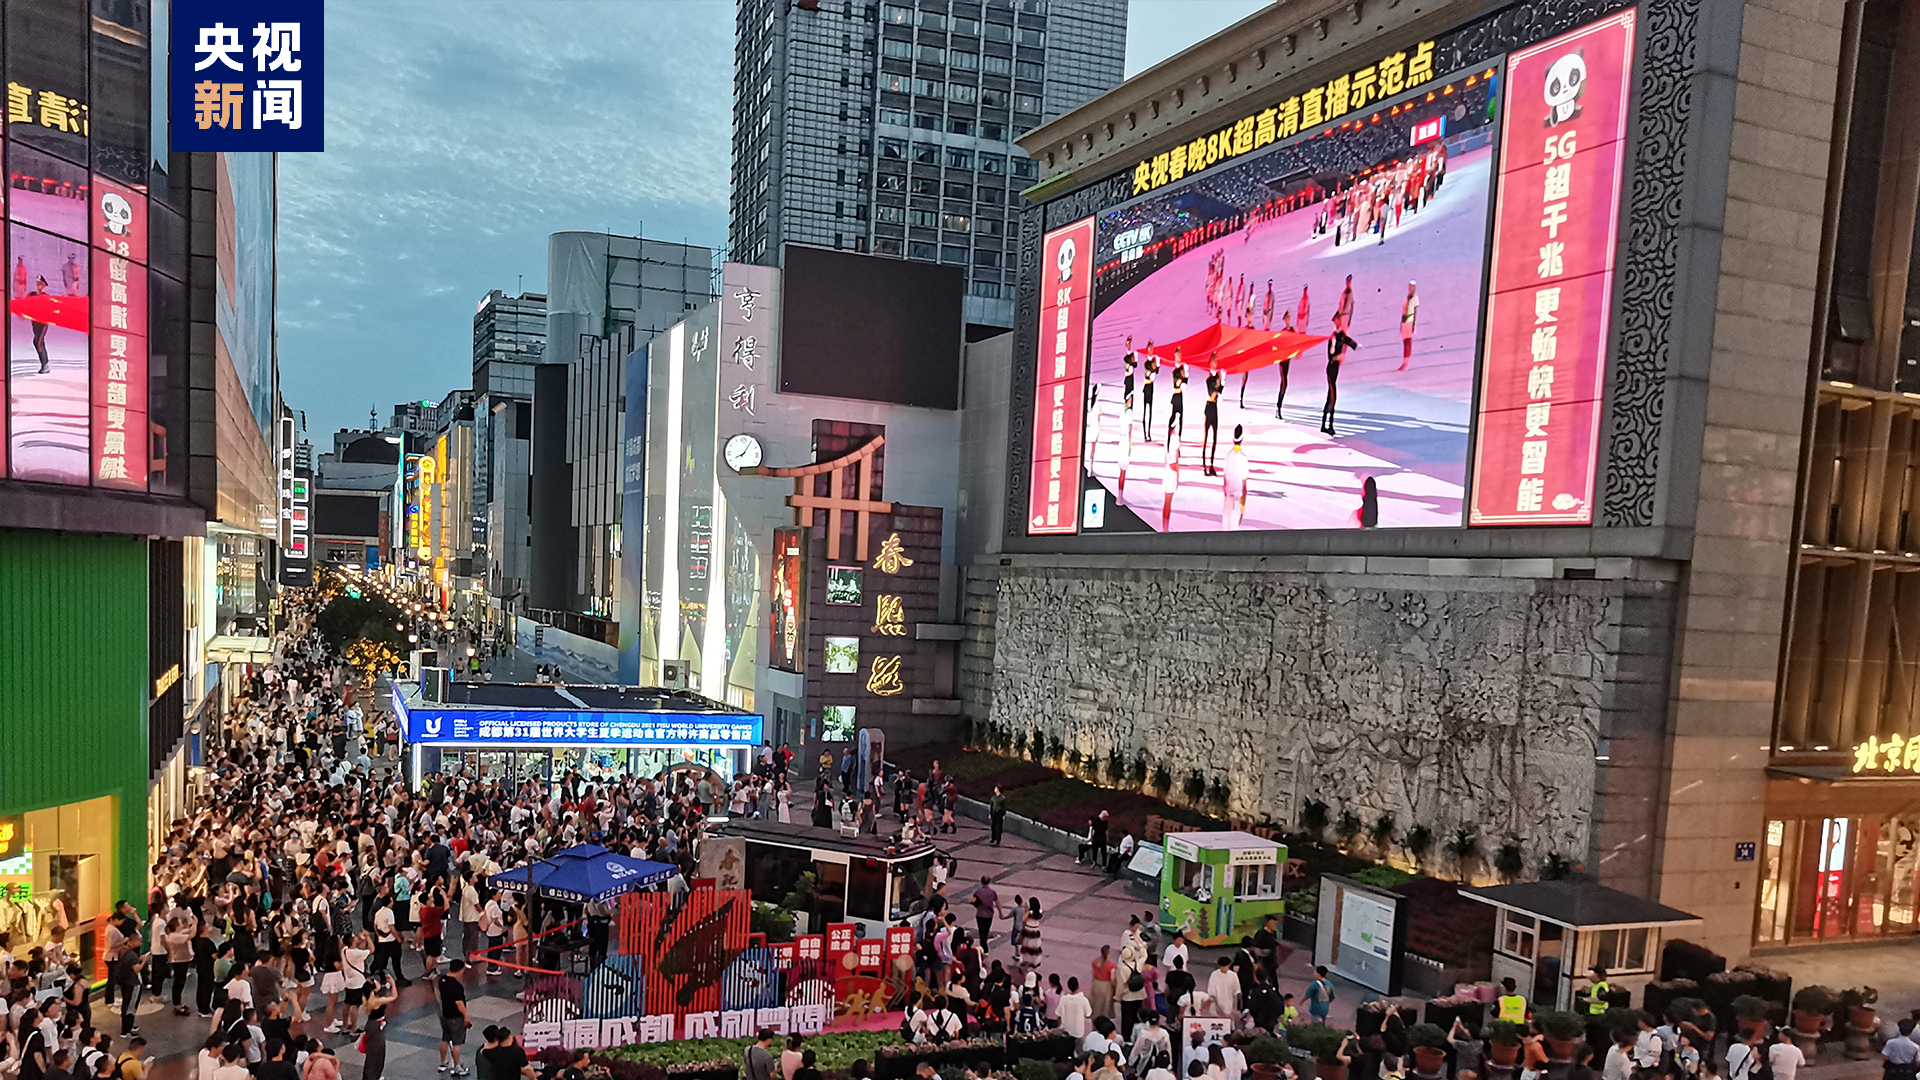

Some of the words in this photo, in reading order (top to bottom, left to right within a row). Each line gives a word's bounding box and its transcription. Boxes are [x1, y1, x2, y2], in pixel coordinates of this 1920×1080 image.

[1133, 41, 1435, 196] 央视春晚8K超高清直播示范点
[1114, 229, 1140, 250] CCTV
[1537, 130, 1577, 279] 5G超千兆
[729, 287, 761, 416] 亨得利
[1516, 287, 1561, 512] 更畅快更智能
[866, 532, 914, 697] 春熙路
[694, 723, 730, 731] UNIVERSITY
[523, 1015, 675, 1050] 幸福成都
